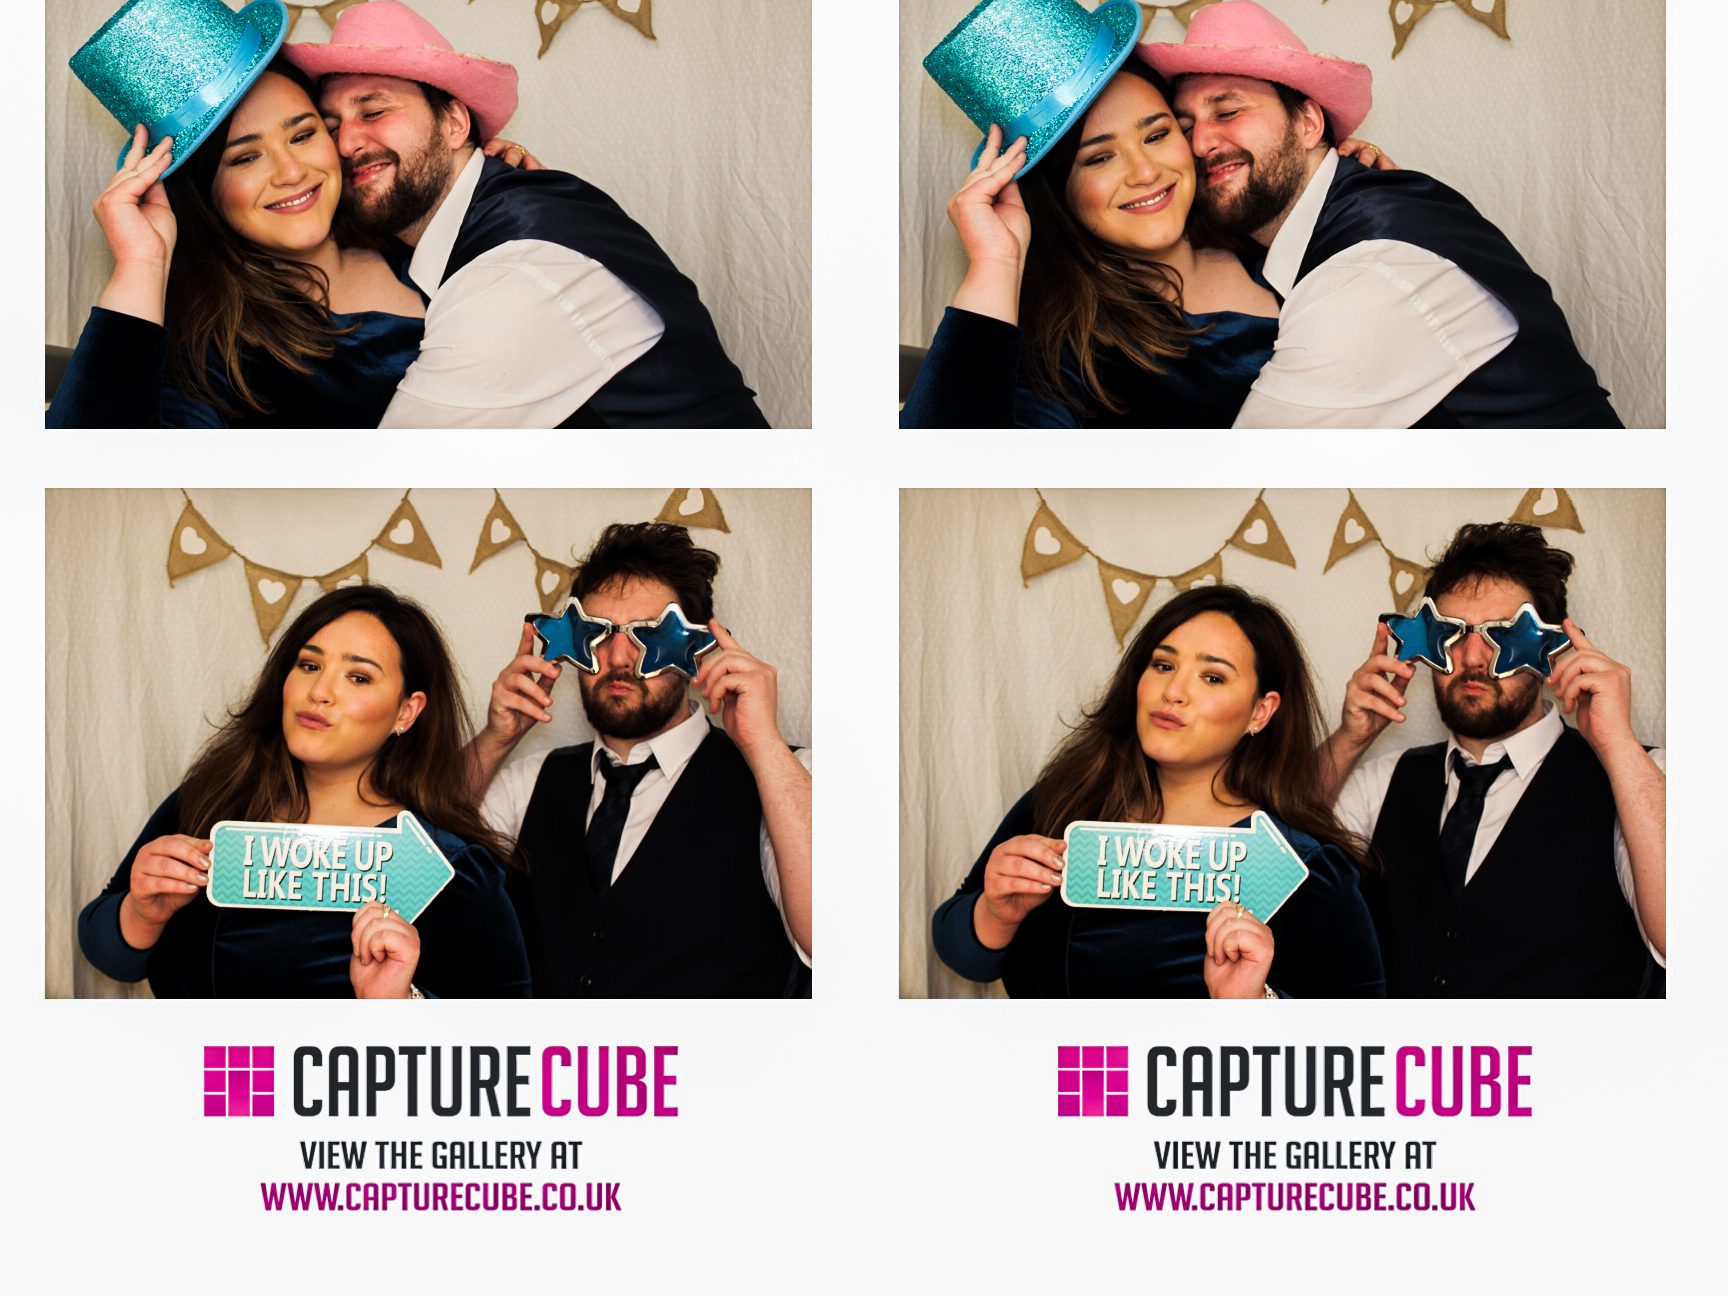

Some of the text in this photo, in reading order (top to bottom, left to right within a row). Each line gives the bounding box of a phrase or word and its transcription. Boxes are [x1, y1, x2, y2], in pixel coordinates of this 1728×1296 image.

[243, 835, 394, 872] I WOKE UP
[1097, 835, 1248, 872] I WOKE UP
[242, 868, 388, 904] LIKE THIS!
[1096, 868, 1242, 904] LIKE THIS!
